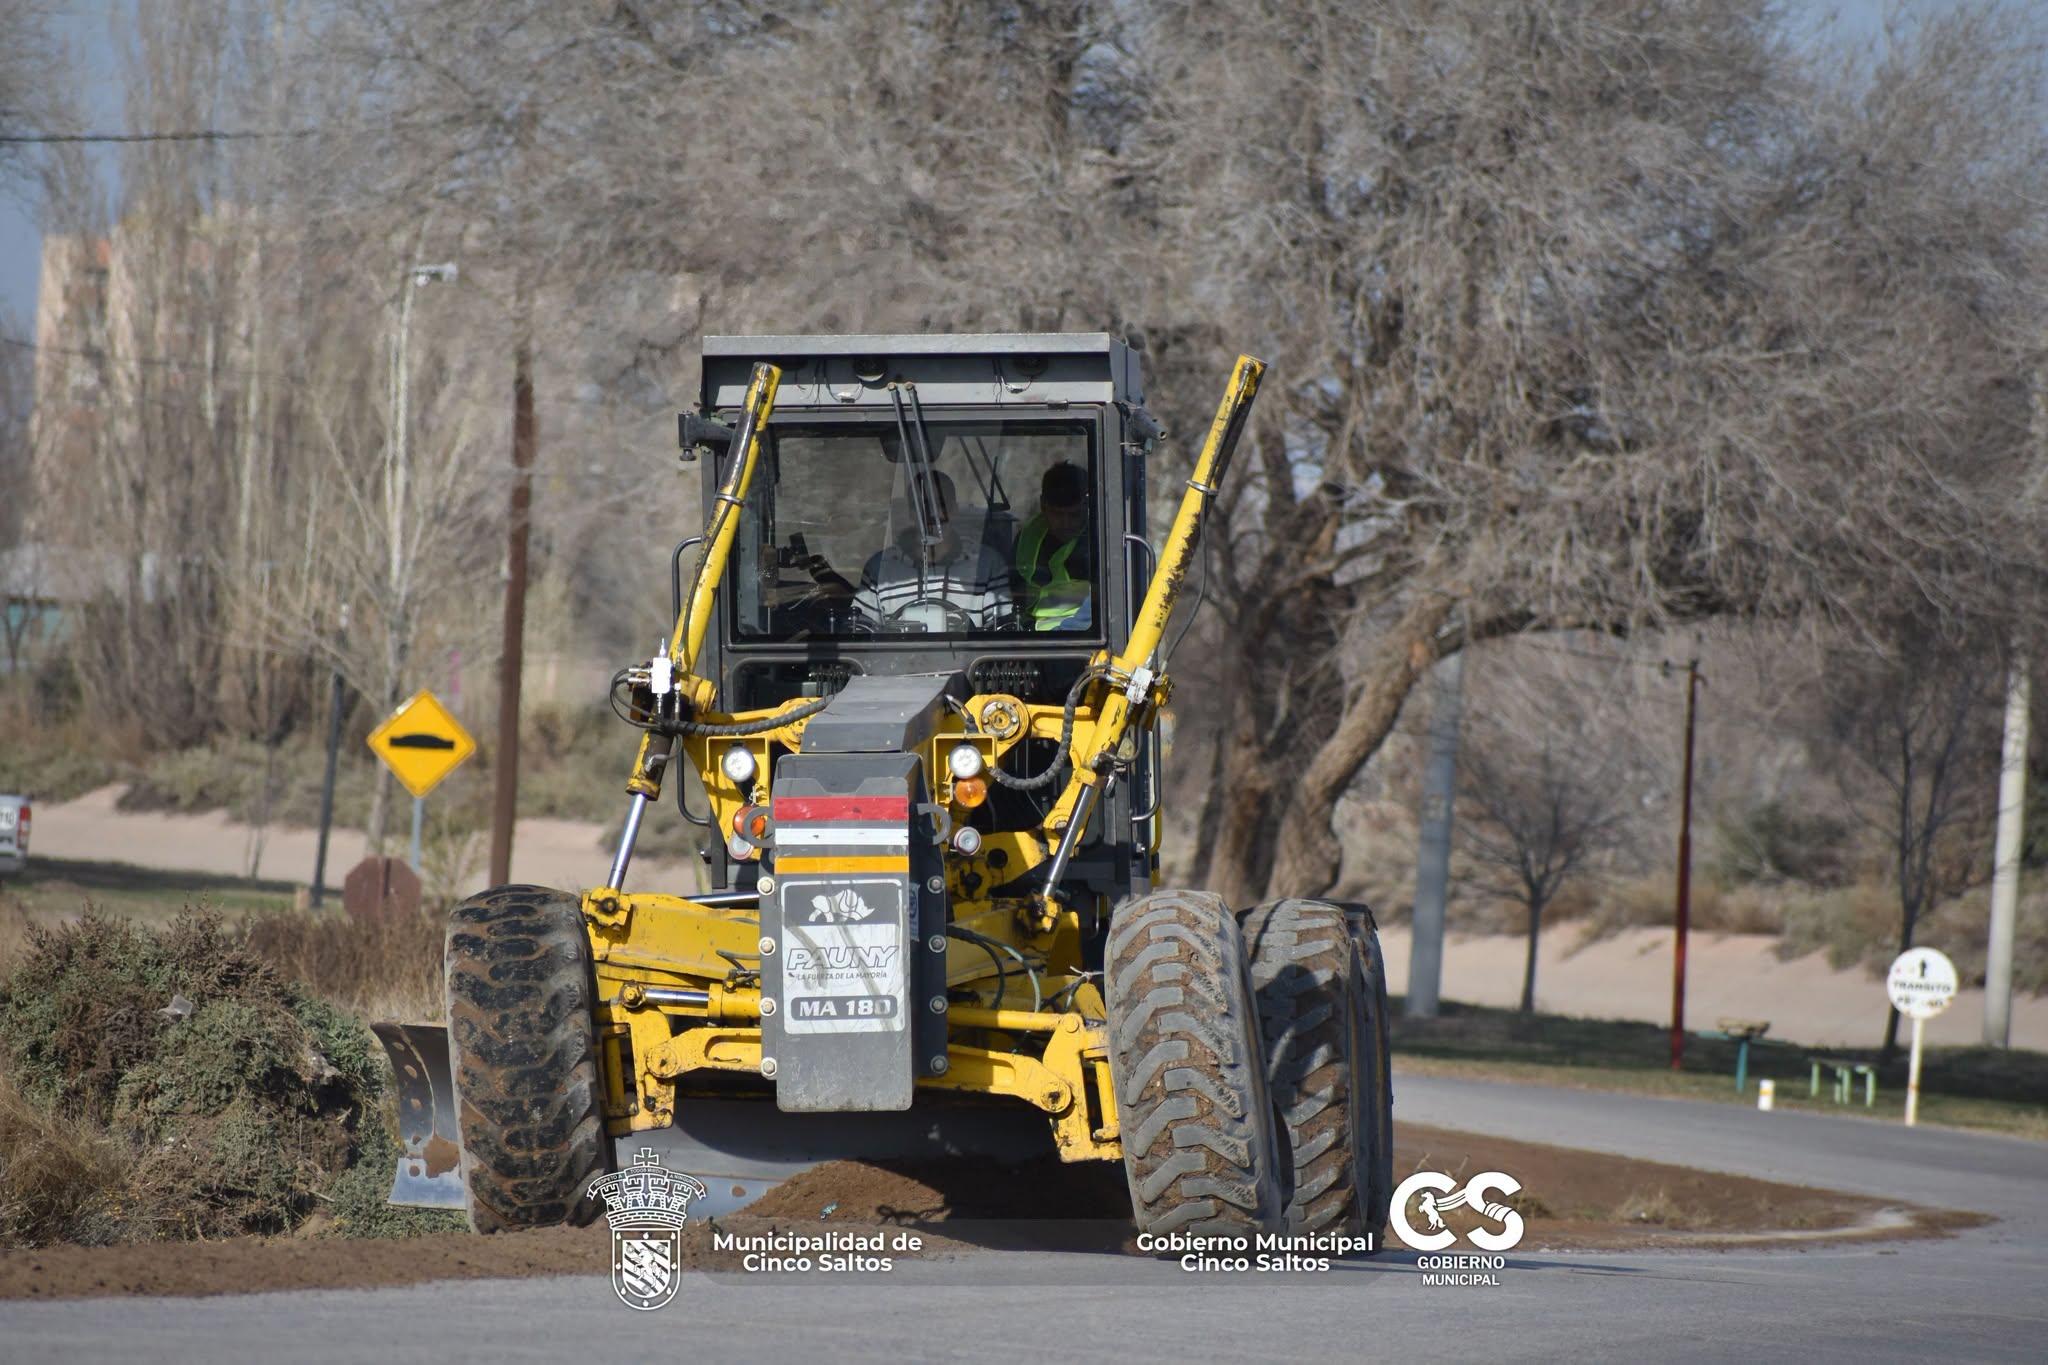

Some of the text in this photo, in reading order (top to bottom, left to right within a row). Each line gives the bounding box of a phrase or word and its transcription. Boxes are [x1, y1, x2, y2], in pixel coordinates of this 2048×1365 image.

[787, 946, 899, 971] PAUNY
[800, 999, 891, 1016] MA 180
